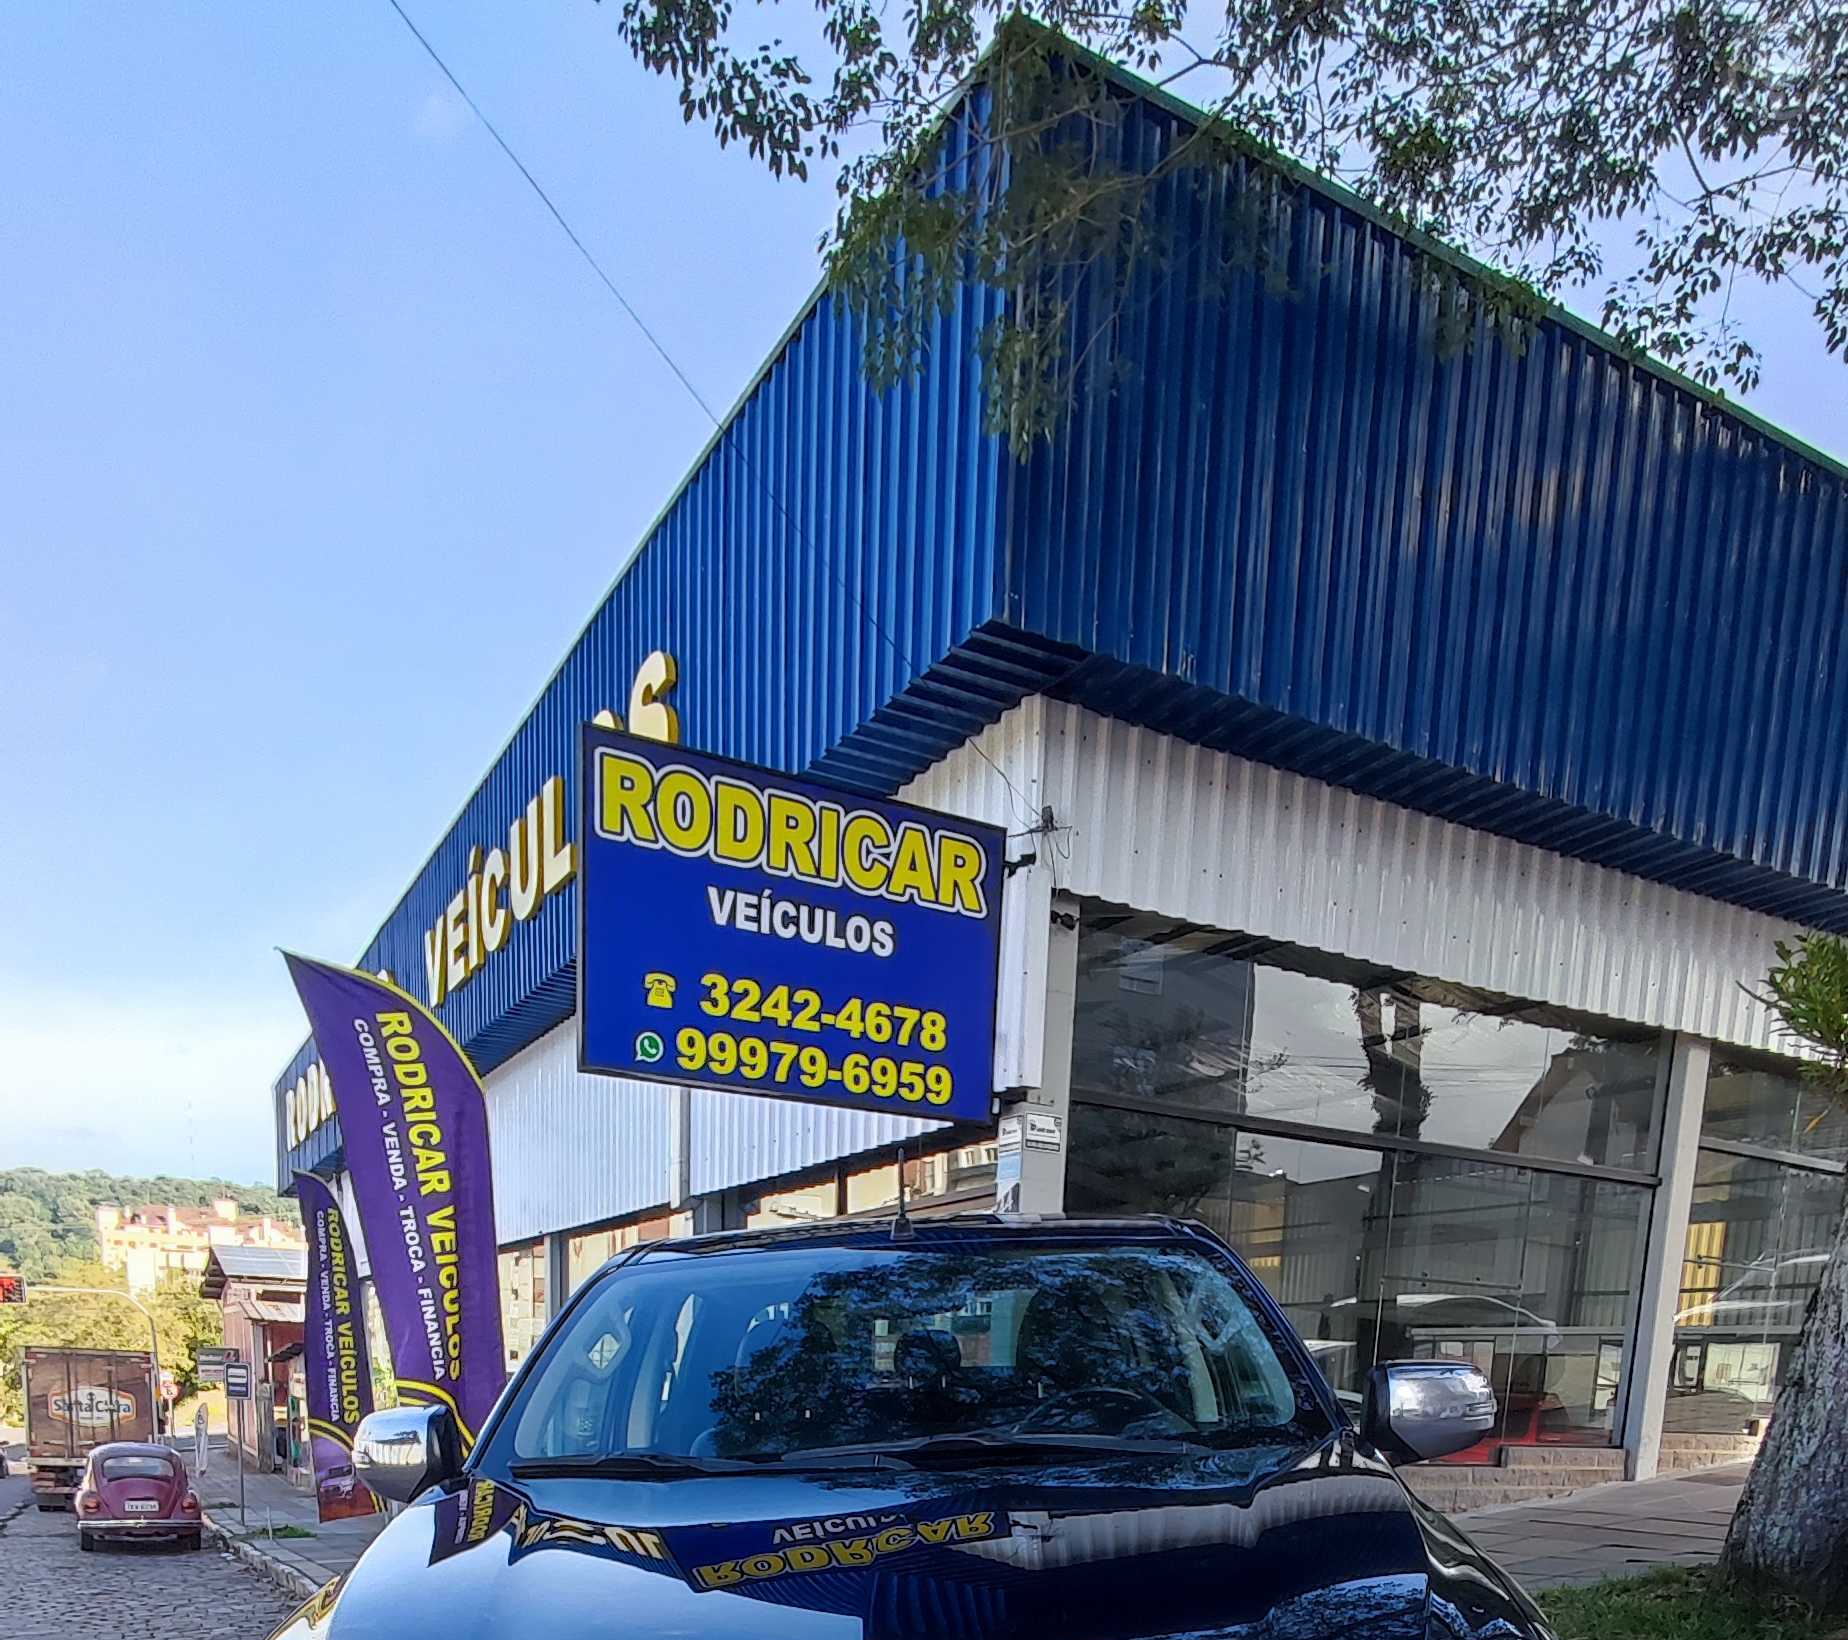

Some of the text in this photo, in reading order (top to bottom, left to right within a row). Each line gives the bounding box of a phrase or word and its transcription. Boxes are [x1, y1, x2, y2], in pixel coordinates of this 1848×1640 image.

[597, 752, 985, 914] RODRICAR
[707, 886, 895, 957] VEÍCULOS
[699, 973, 946, 1051] 3242-4678
[376, 1011, 450, 1196] RODRICAR
[676, 1027, 952, 1104] 99979-6959
[316, 1210, 328, 1263] COMPRA
[354, 1018, 391, 1106] COMPRA
[382, 1122, 407, 1191] VENDA
[400, 1205, 426, 1273] TROCA
[418, 1288, 446, 1381] FINANCIA
[320, 1270, 332, 1311] VENDA
[327, 1207, 351, 1315] RODRICAR
[325, 1319, 336, 1360] TROCA
[328, 1367, 340, 1422] FINANCIA
